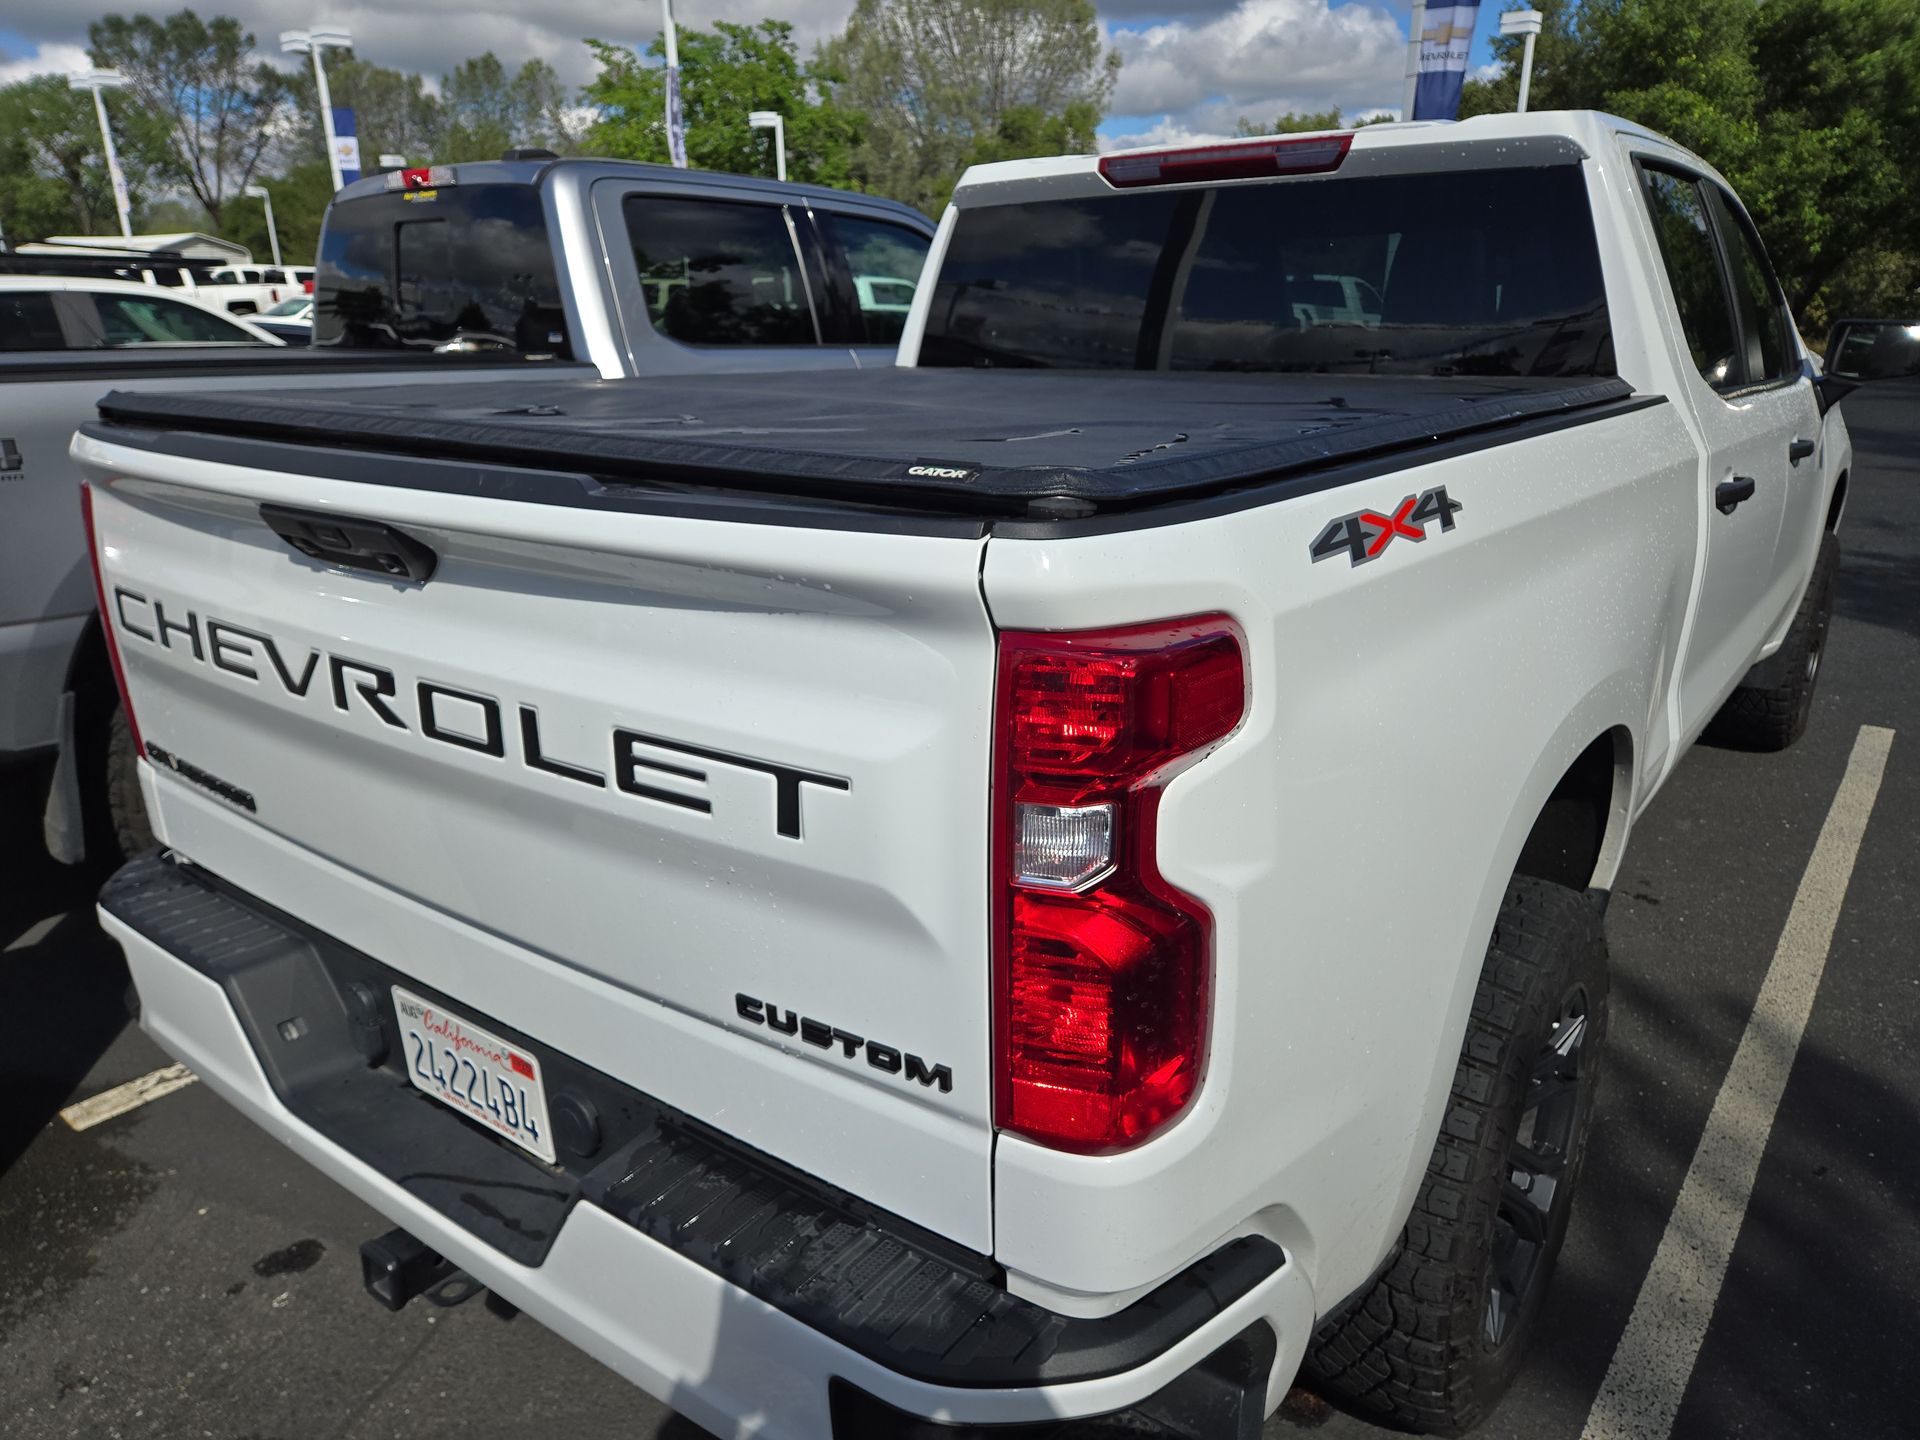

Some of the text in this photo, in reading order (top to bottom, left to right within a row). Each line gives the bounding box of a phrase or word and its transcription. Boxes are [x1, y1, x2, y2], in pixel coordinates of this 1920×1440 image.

[908, 466, 967, 479] GATOR
[113, 585, 851, 840] CHEVROLET
[410, 1031, 539, 1143] 24224B4
[423, 1008, 510, 1070] California
[735, 992, 953, 1094] CUSTOM
